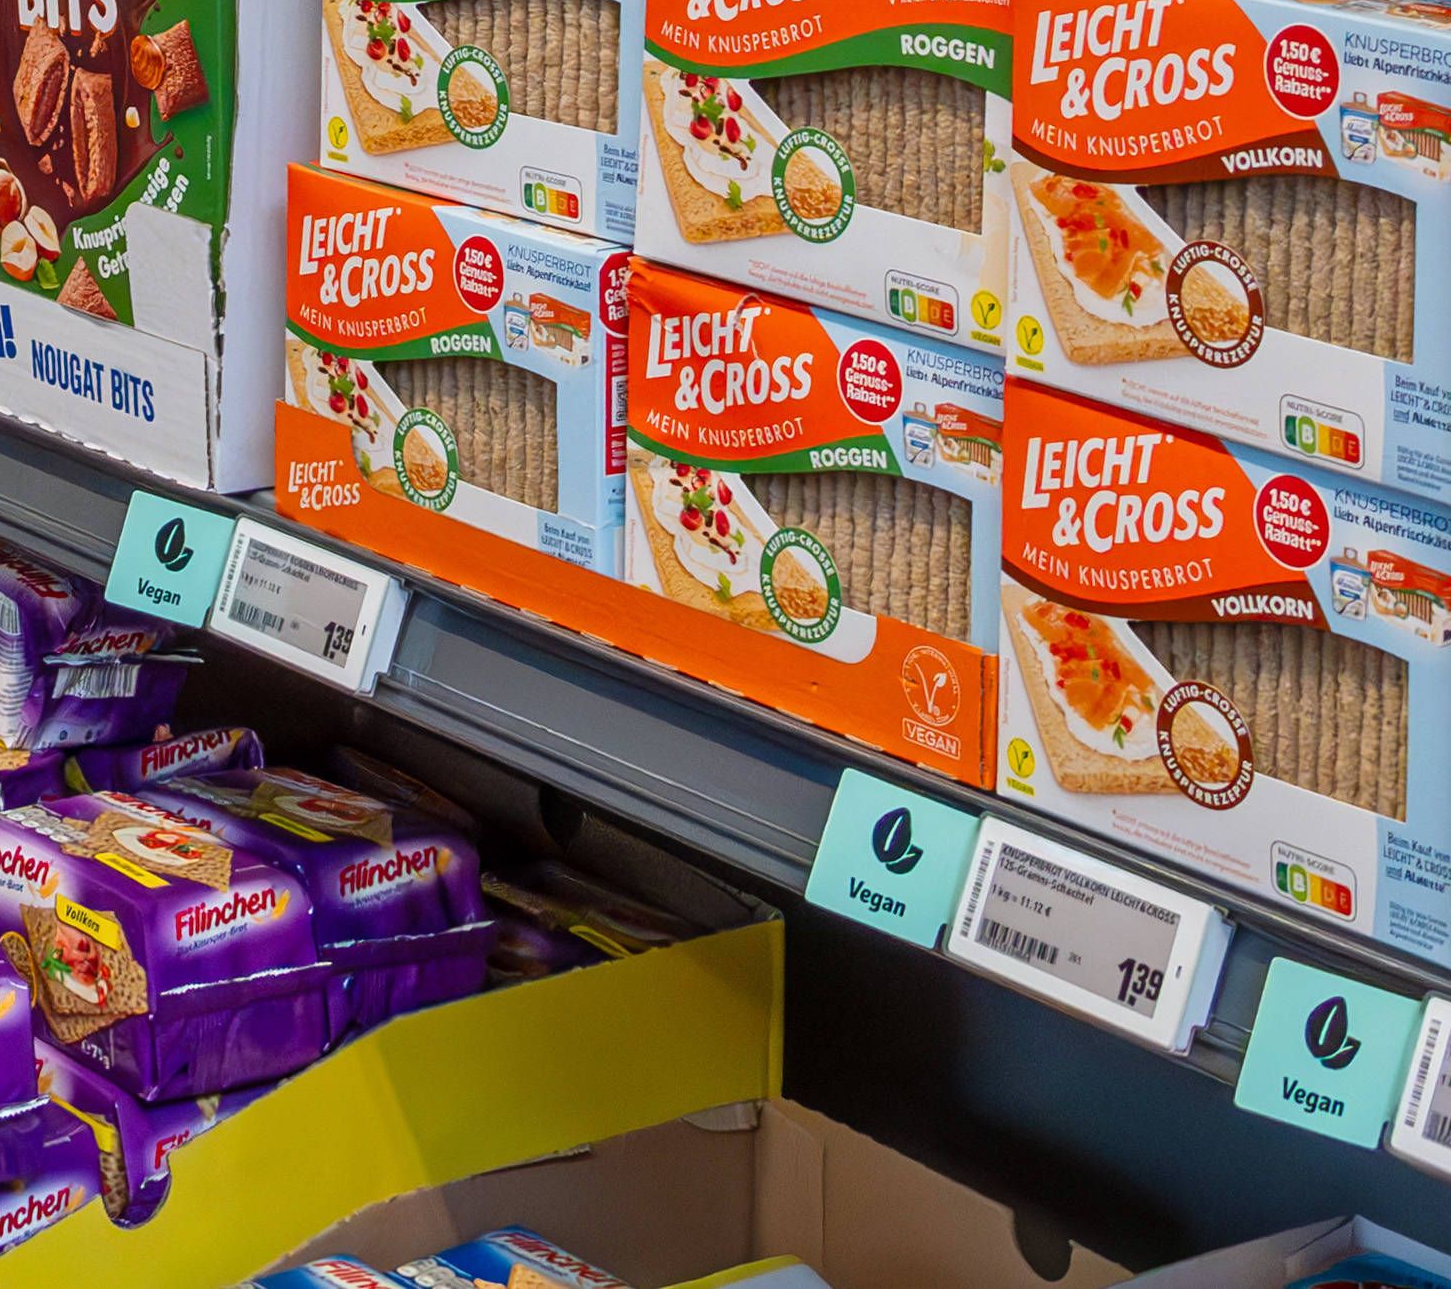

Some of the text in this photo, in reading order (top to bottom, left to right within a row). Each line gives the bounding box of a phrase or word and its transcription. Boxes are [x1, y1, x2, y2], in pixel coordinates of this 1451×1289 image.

[900, 32, 997, 71] ROGGEN
[1060, 42, 1236, 122] &CROSS
[1220, 145, 1323, 174] VOLLKORN
[31, 340, 155, 423] NOUGAT BITS
[322, 621, 355, 663] 1.39
[905, 723, 958, 756] VEGAN
[63, 903, 103, 933] Vollkorn
[175, 889, 278, 942] Filinchen
[849, 876, 907, 919] Vegan
[1117, 957, 1164, 1008] 1.39
[1281, 1077, 1345, 1118] Vegan
